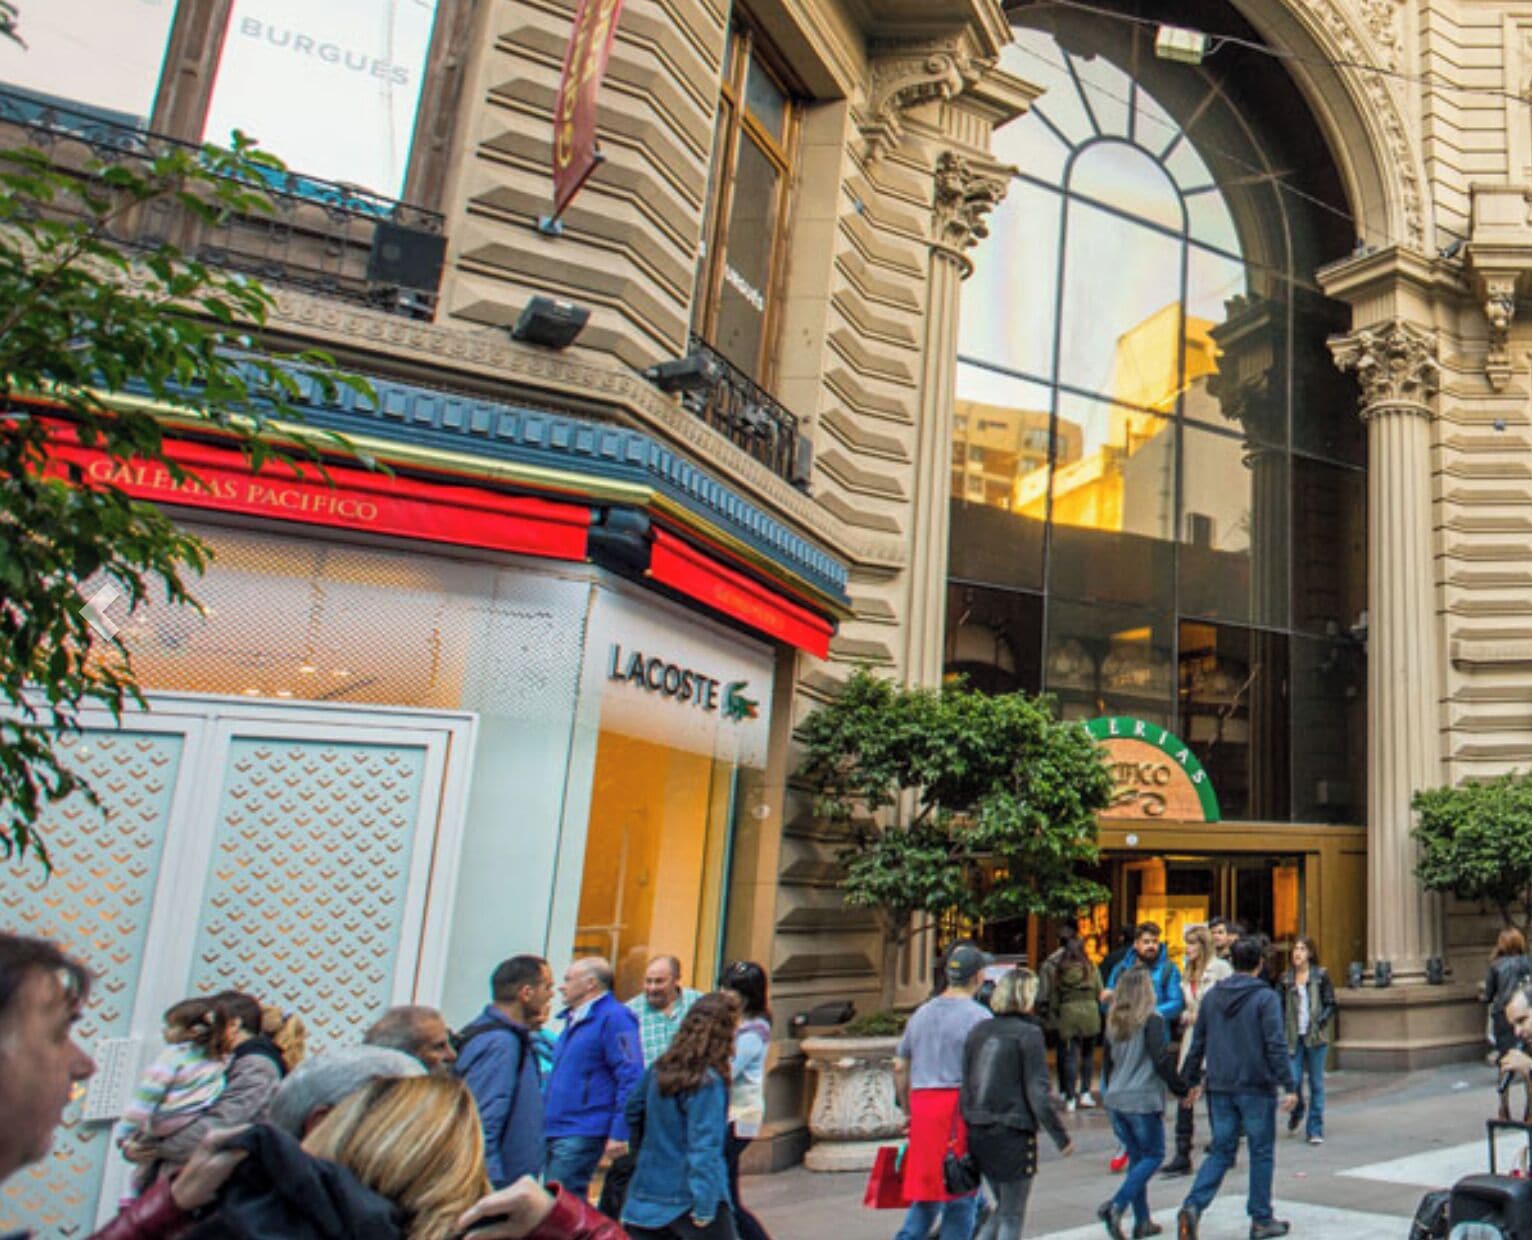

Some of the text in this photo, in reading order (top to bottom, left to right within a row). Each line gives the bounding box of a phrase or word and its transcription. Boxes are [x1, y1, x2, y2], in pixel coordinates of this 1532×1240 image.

[240, 16, 409, 86] BURGUES
[247, 483, 378, 520] PACIFICO
[608, 643, 720, 711] LACOSTE
